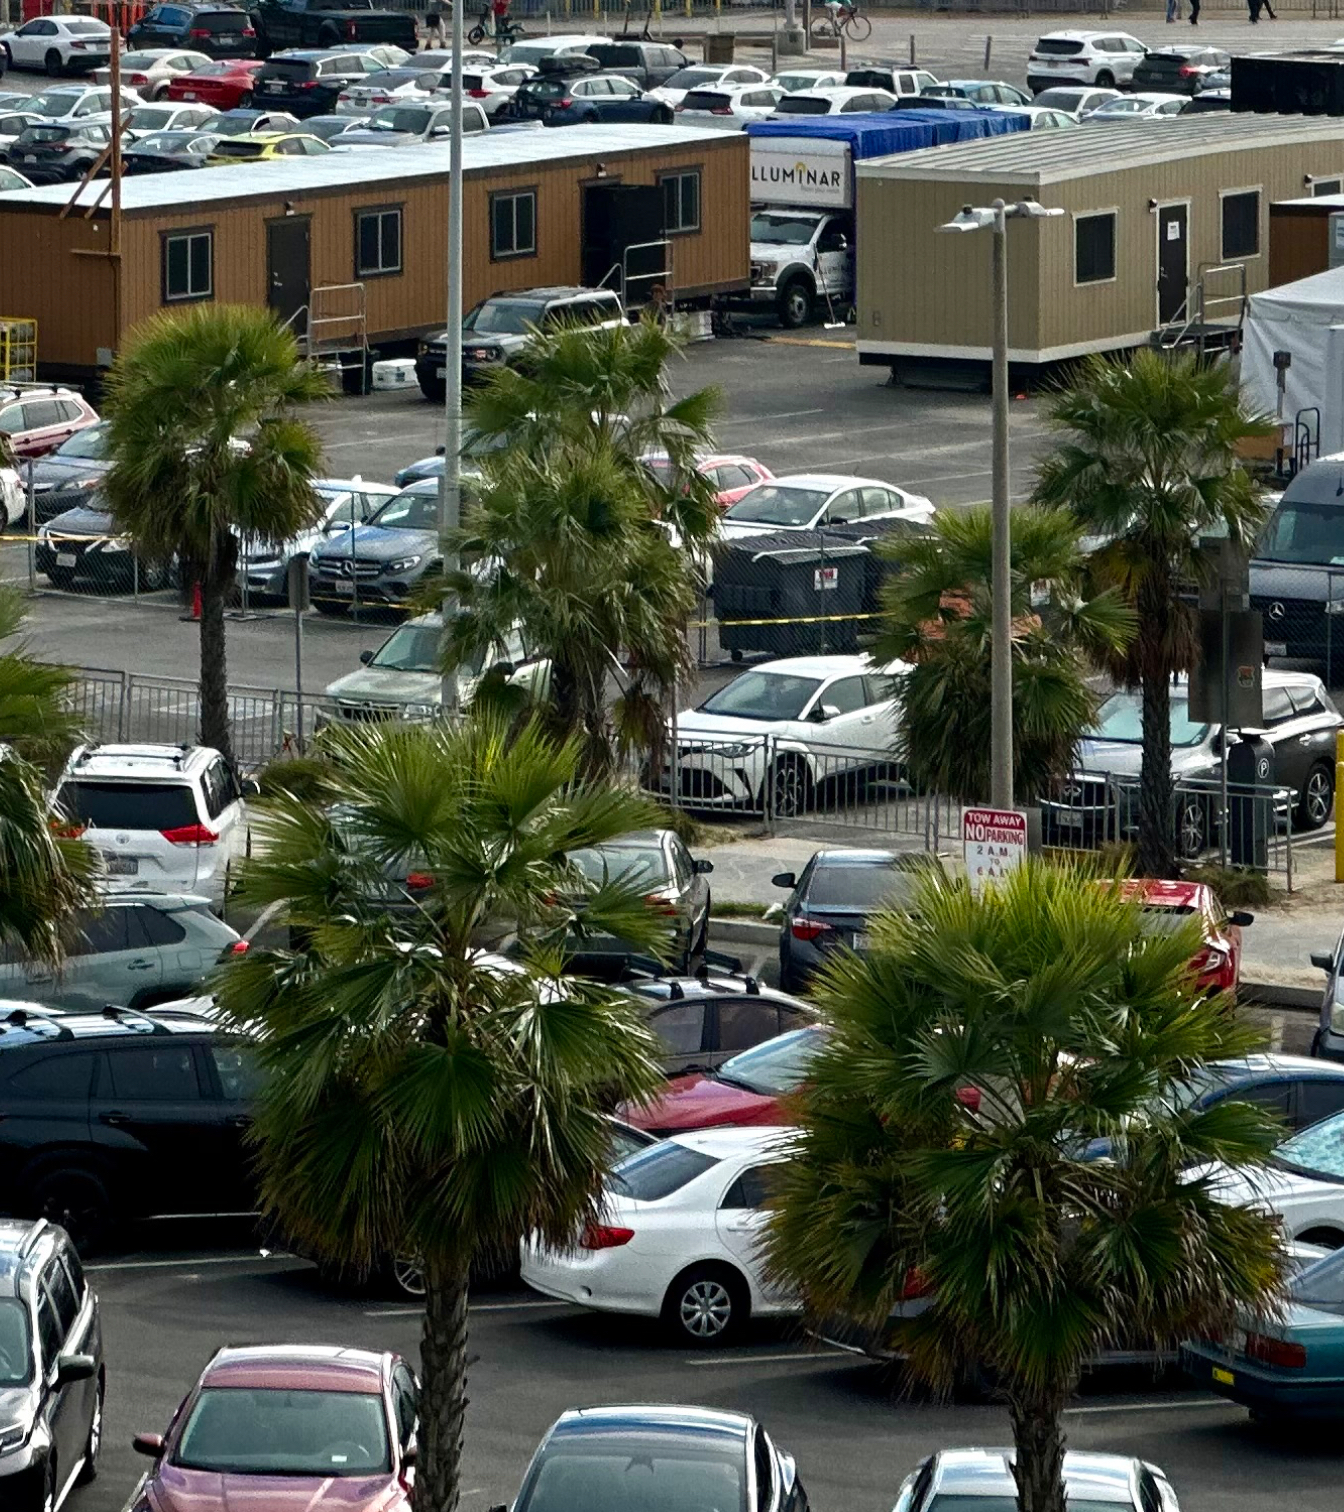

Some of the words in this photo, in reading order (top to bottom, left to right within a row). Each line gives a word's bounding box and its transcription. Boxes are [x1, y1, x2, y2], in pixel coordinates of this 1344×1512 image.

[967, 812, 991, 824] TOW
[993, 814, 1022, 826] AWAY
[965, 822, 985, 841] NO
[986, 829, 1024, 846] PARKING
[977, 845, 983, 855] 2
